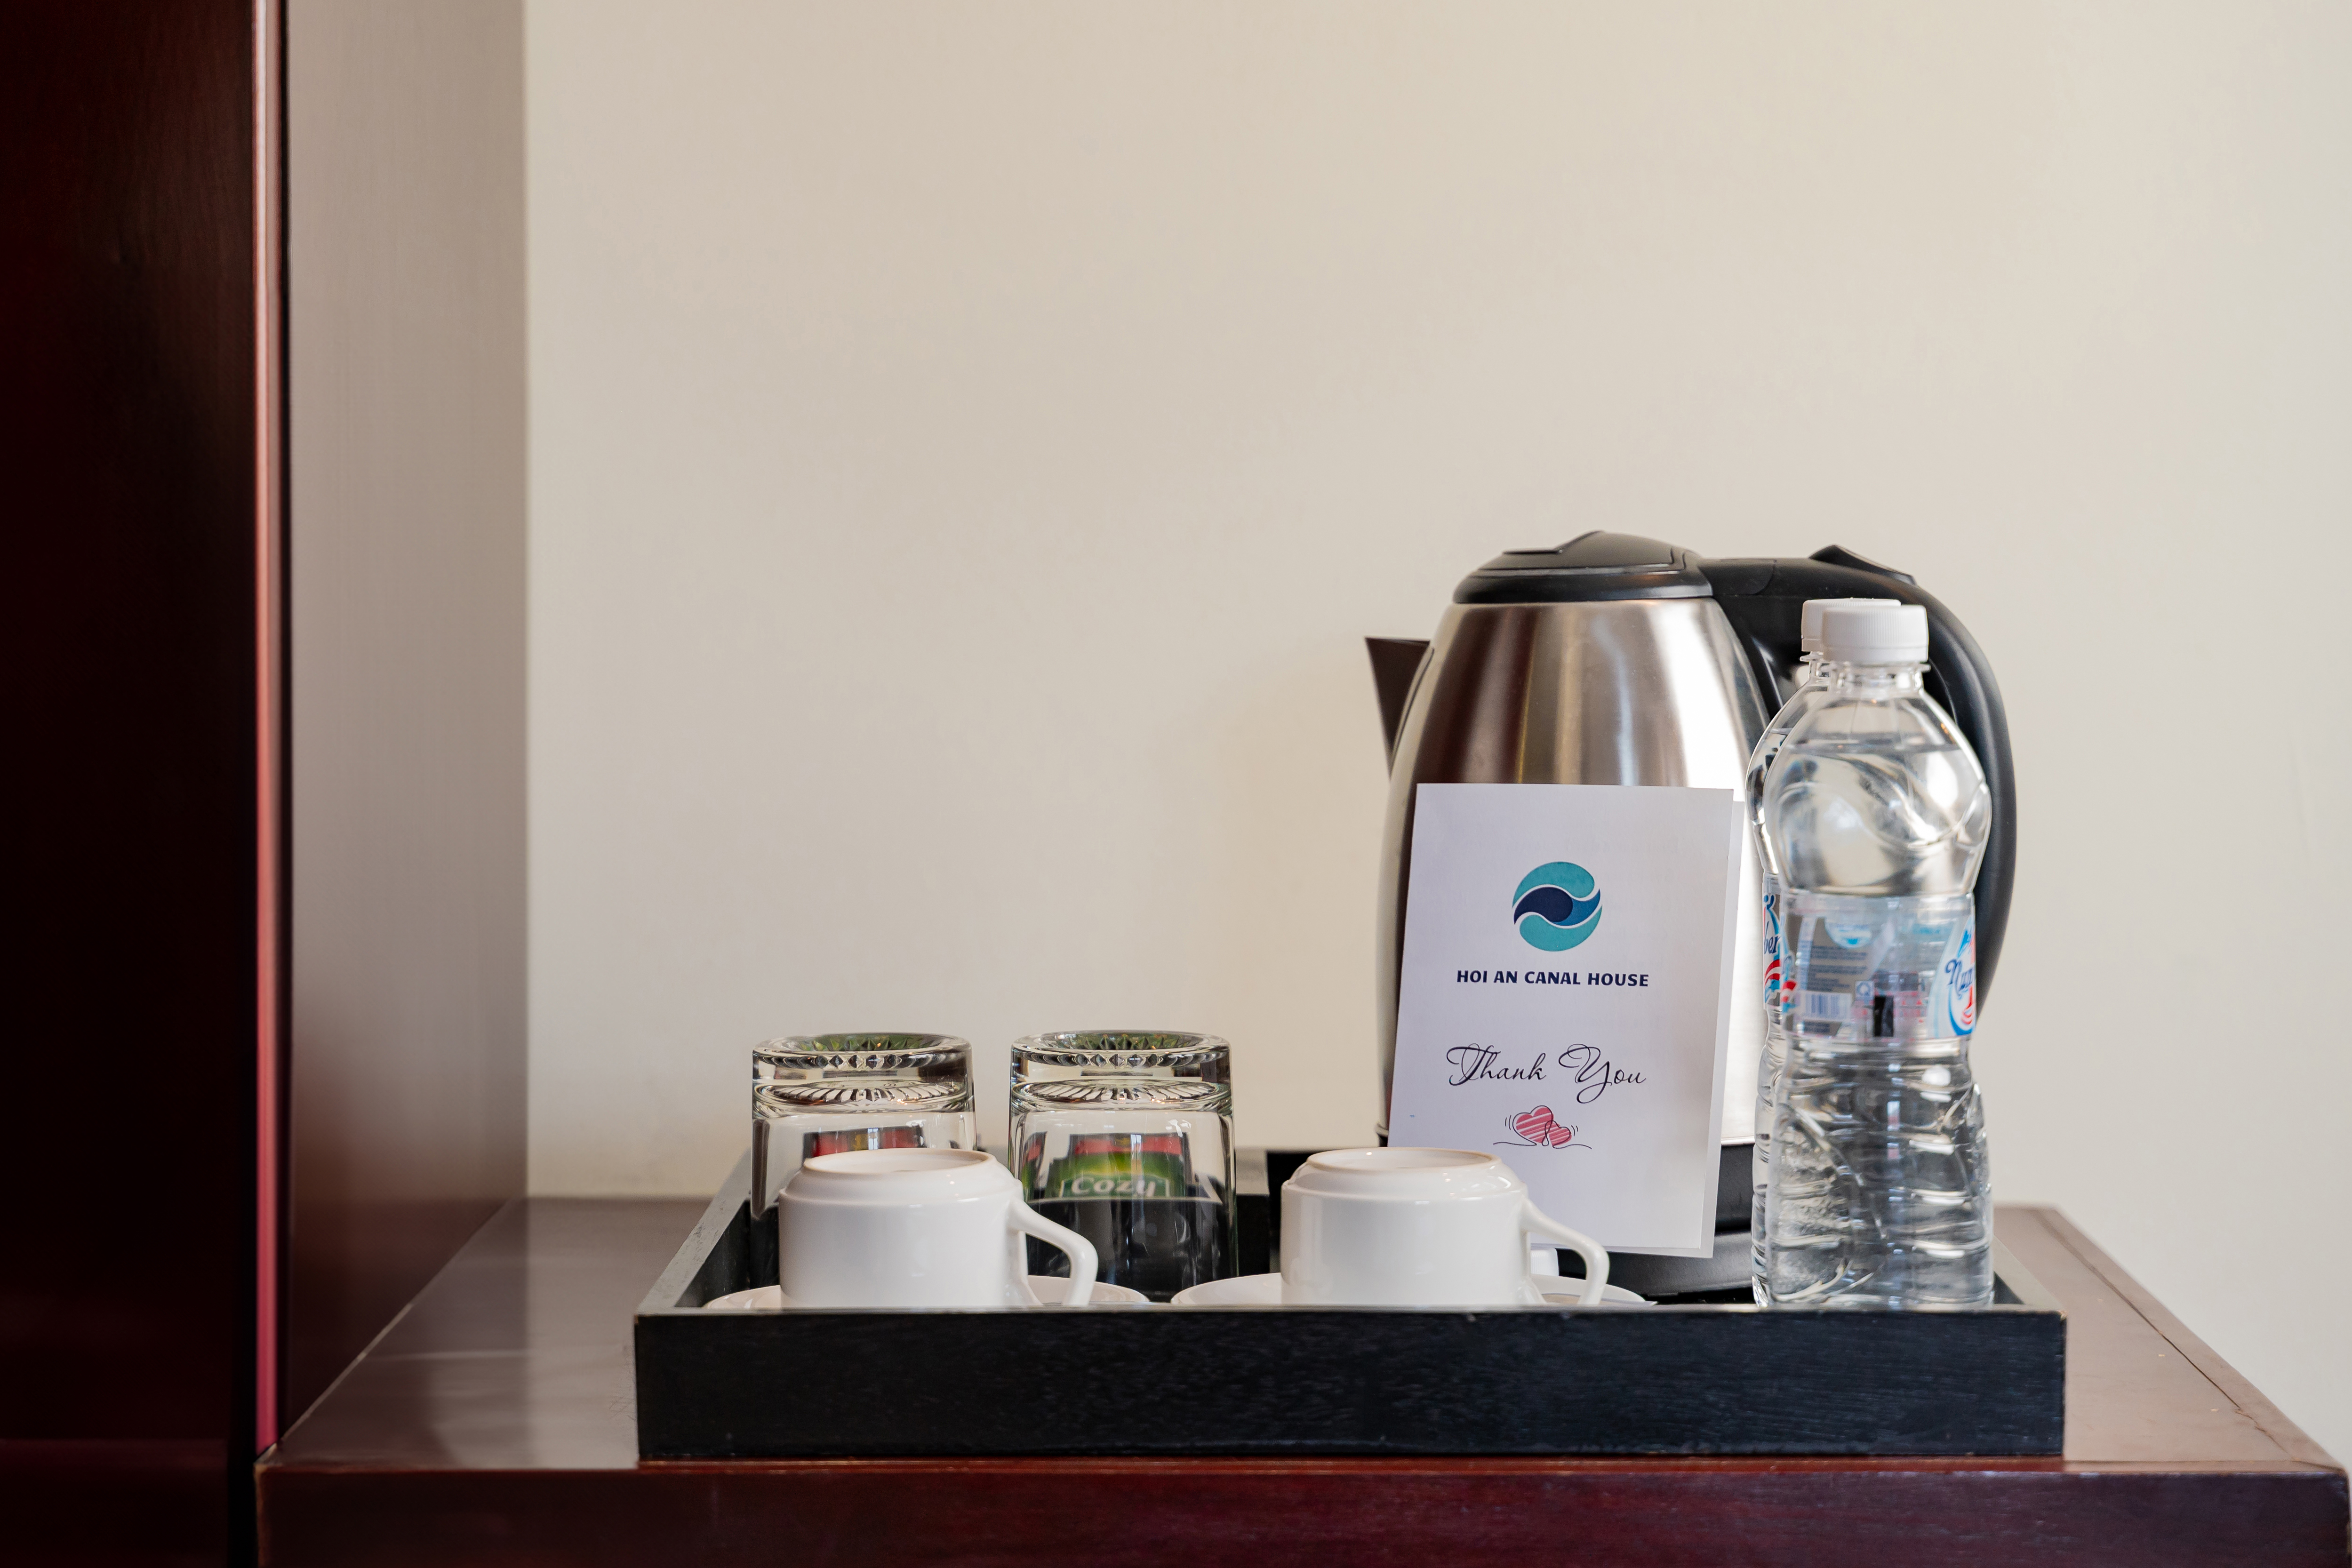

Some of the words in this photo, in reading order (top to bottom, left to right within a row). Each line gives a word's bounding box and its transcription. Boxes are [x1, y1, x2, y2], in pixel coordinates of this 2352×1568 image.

[1456, 970, 1488, 983] HOI
[1493, 971, 1518, 984] AN
[1525, 971, 1581, 985] CANAL
[1587, 973, 1649, 987] HOUSE
[1446, 1043, 1547, 1086] Thank
[1558, 1043, 1647, 1104] You
